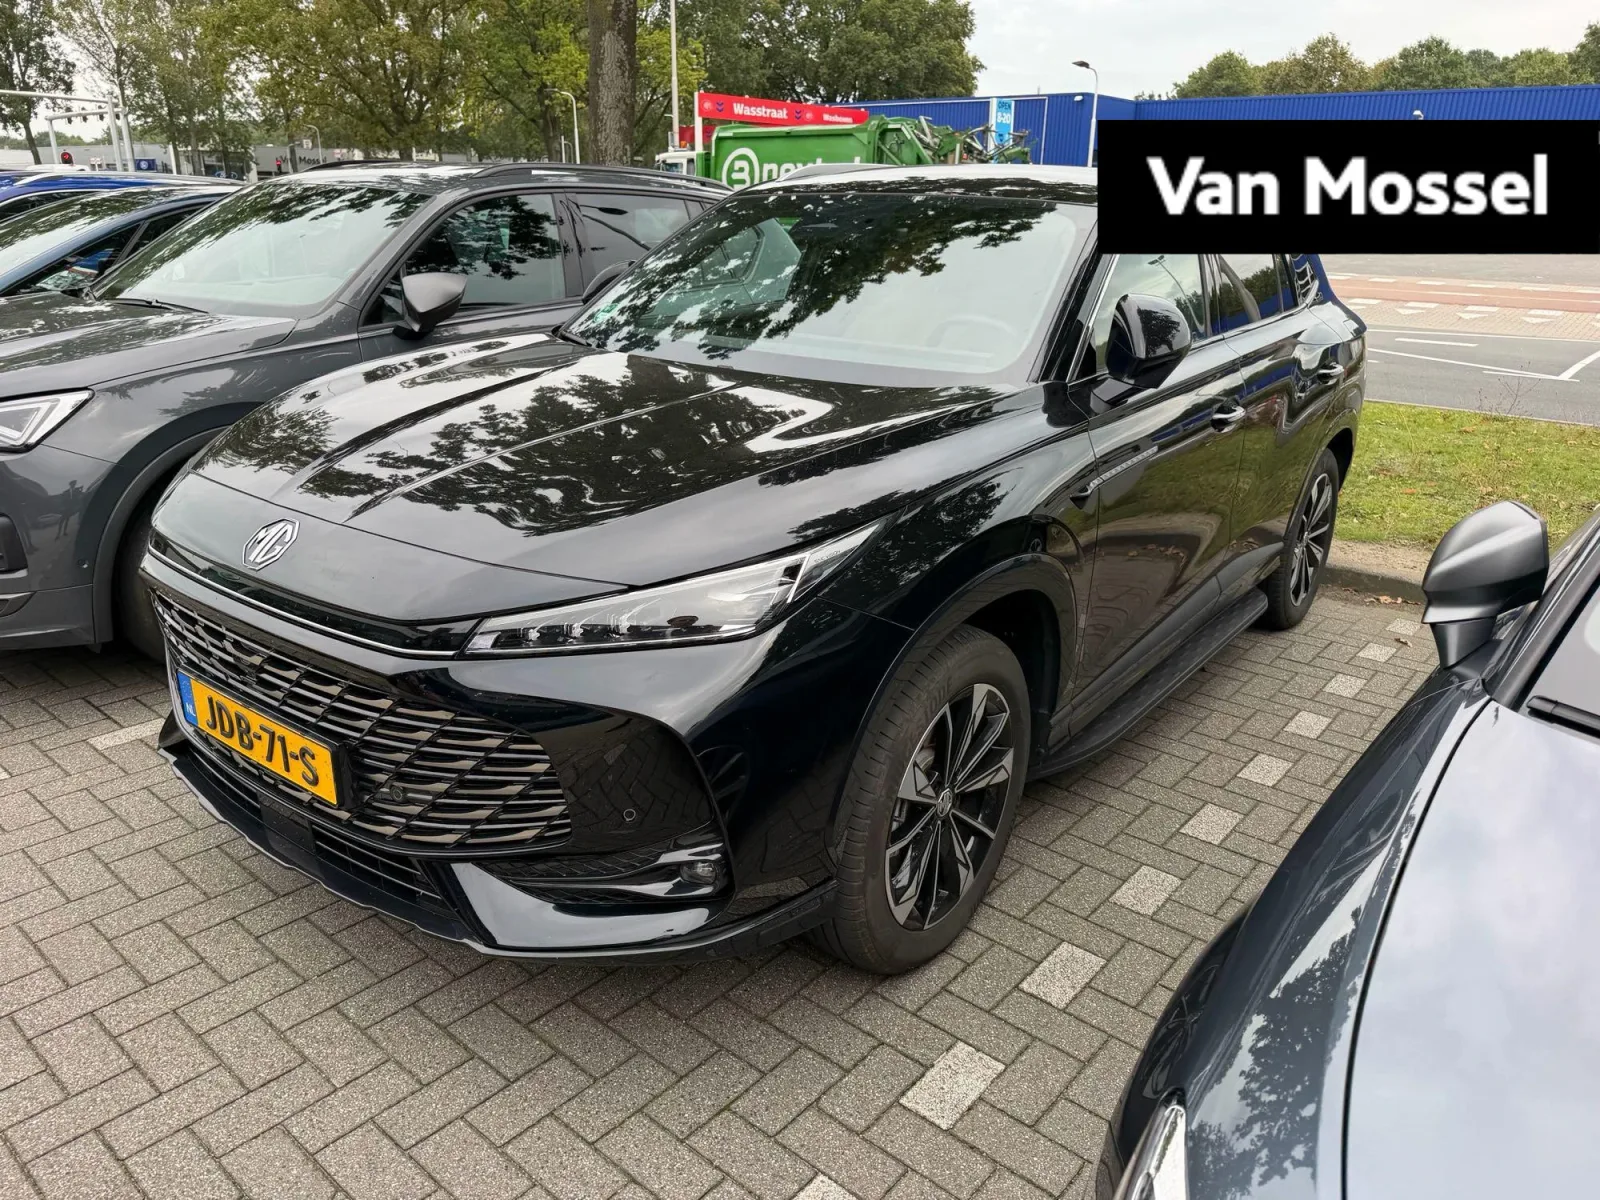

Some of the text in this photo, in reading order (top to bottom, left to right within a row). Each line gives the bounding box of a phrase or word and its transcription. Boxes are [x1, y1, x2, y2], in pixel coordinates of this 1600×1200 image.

[733, 102, 788, 119] Wasstraat
[998, 101, 1011, 110] OPEN
[299, 156, 327, 164] Mossl
[247, 521, 294, 563] MG
[185, 702, 197, 717] NL
[206, 694, 319, 787] JDB-71-S
